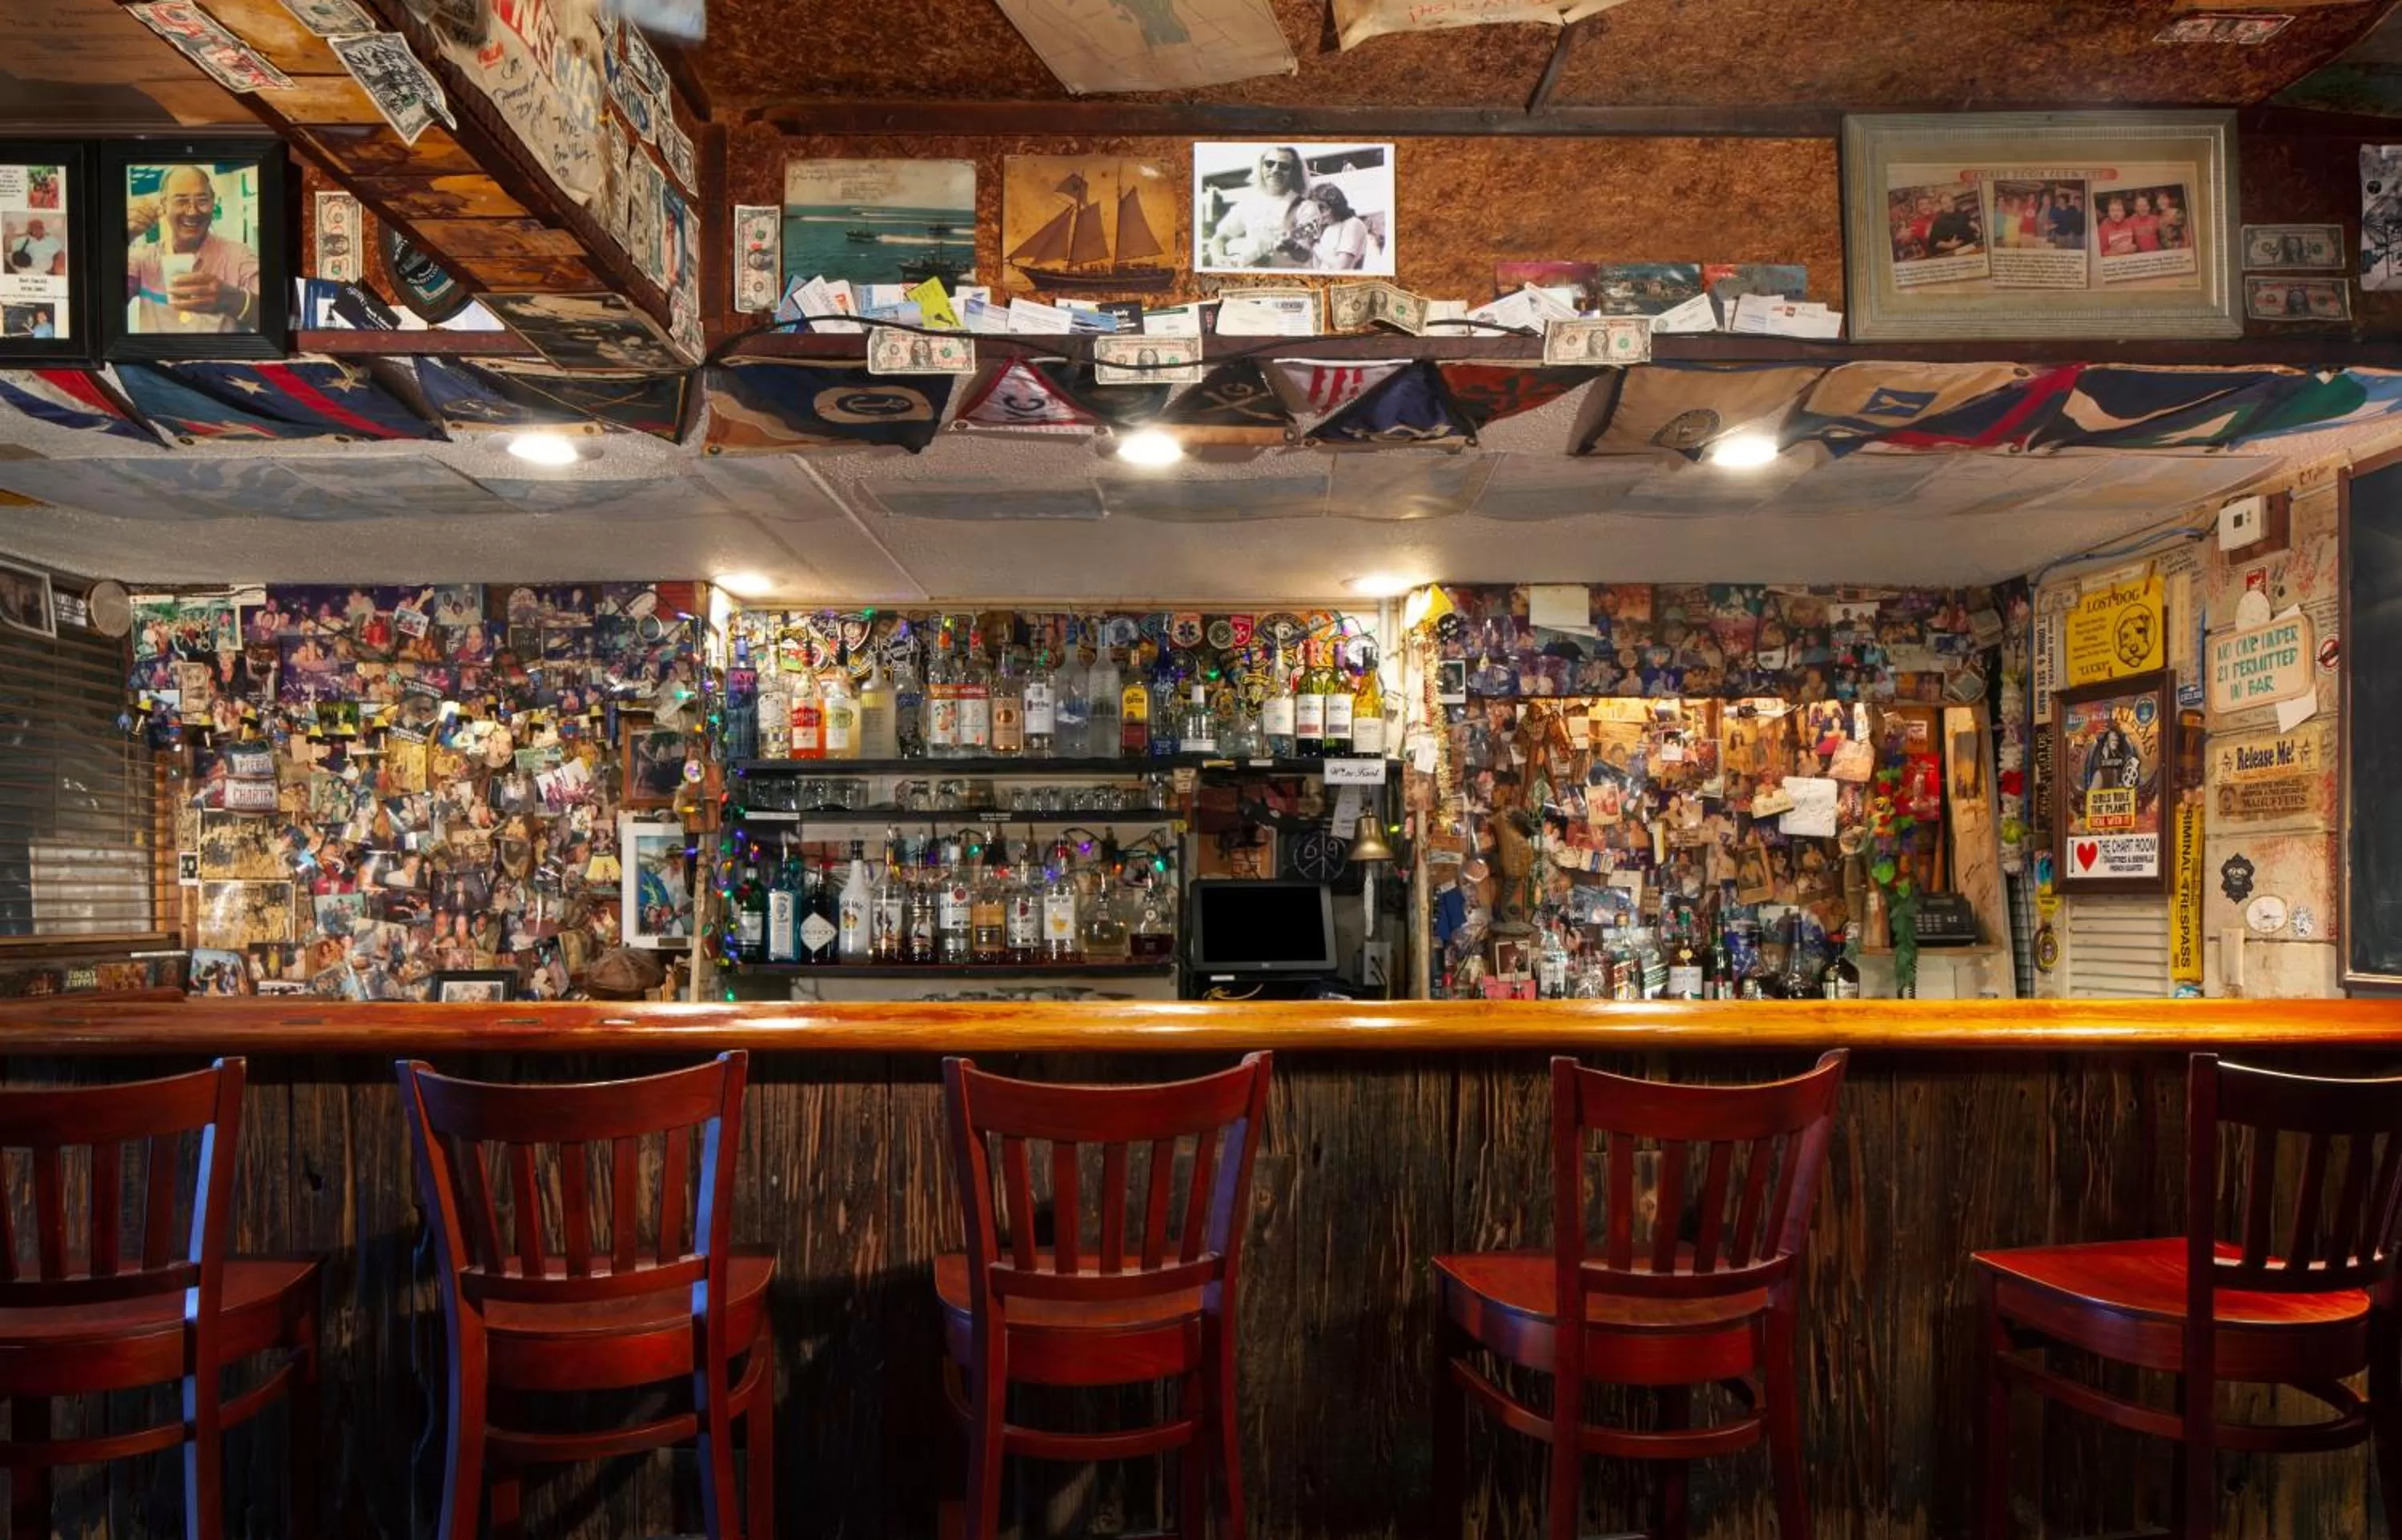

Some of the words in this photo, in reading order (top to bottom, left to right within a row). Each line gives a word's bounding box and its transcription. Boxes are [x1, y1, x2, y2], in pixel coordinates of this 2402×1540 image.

[2086, 596, 2112, 614] LOST
[2115, 588, 2140, 606] DOG
[2217, 642, 2232, 661] NO
[2261, 624, 2299, 650] UNDER
[2217, 665, 2229, 683] 21
[2232, 648, 2299, 680] PERMITTED
[2230, 683, 2243, 701] IN
[2247, 675, 2275, 697] BAR
[2236, 745, 2275, 770] Release
[2276, 739, 2294, 766] Me!
[2105, 803, 2131, 814] PLANET
[2099, 839, 2110, 853] THE
[2111, 838, 2134, 853] CHART
[2135, 837, 2156, 852] ROOM
[2179, 880, 2191, 968] TRESPASS
